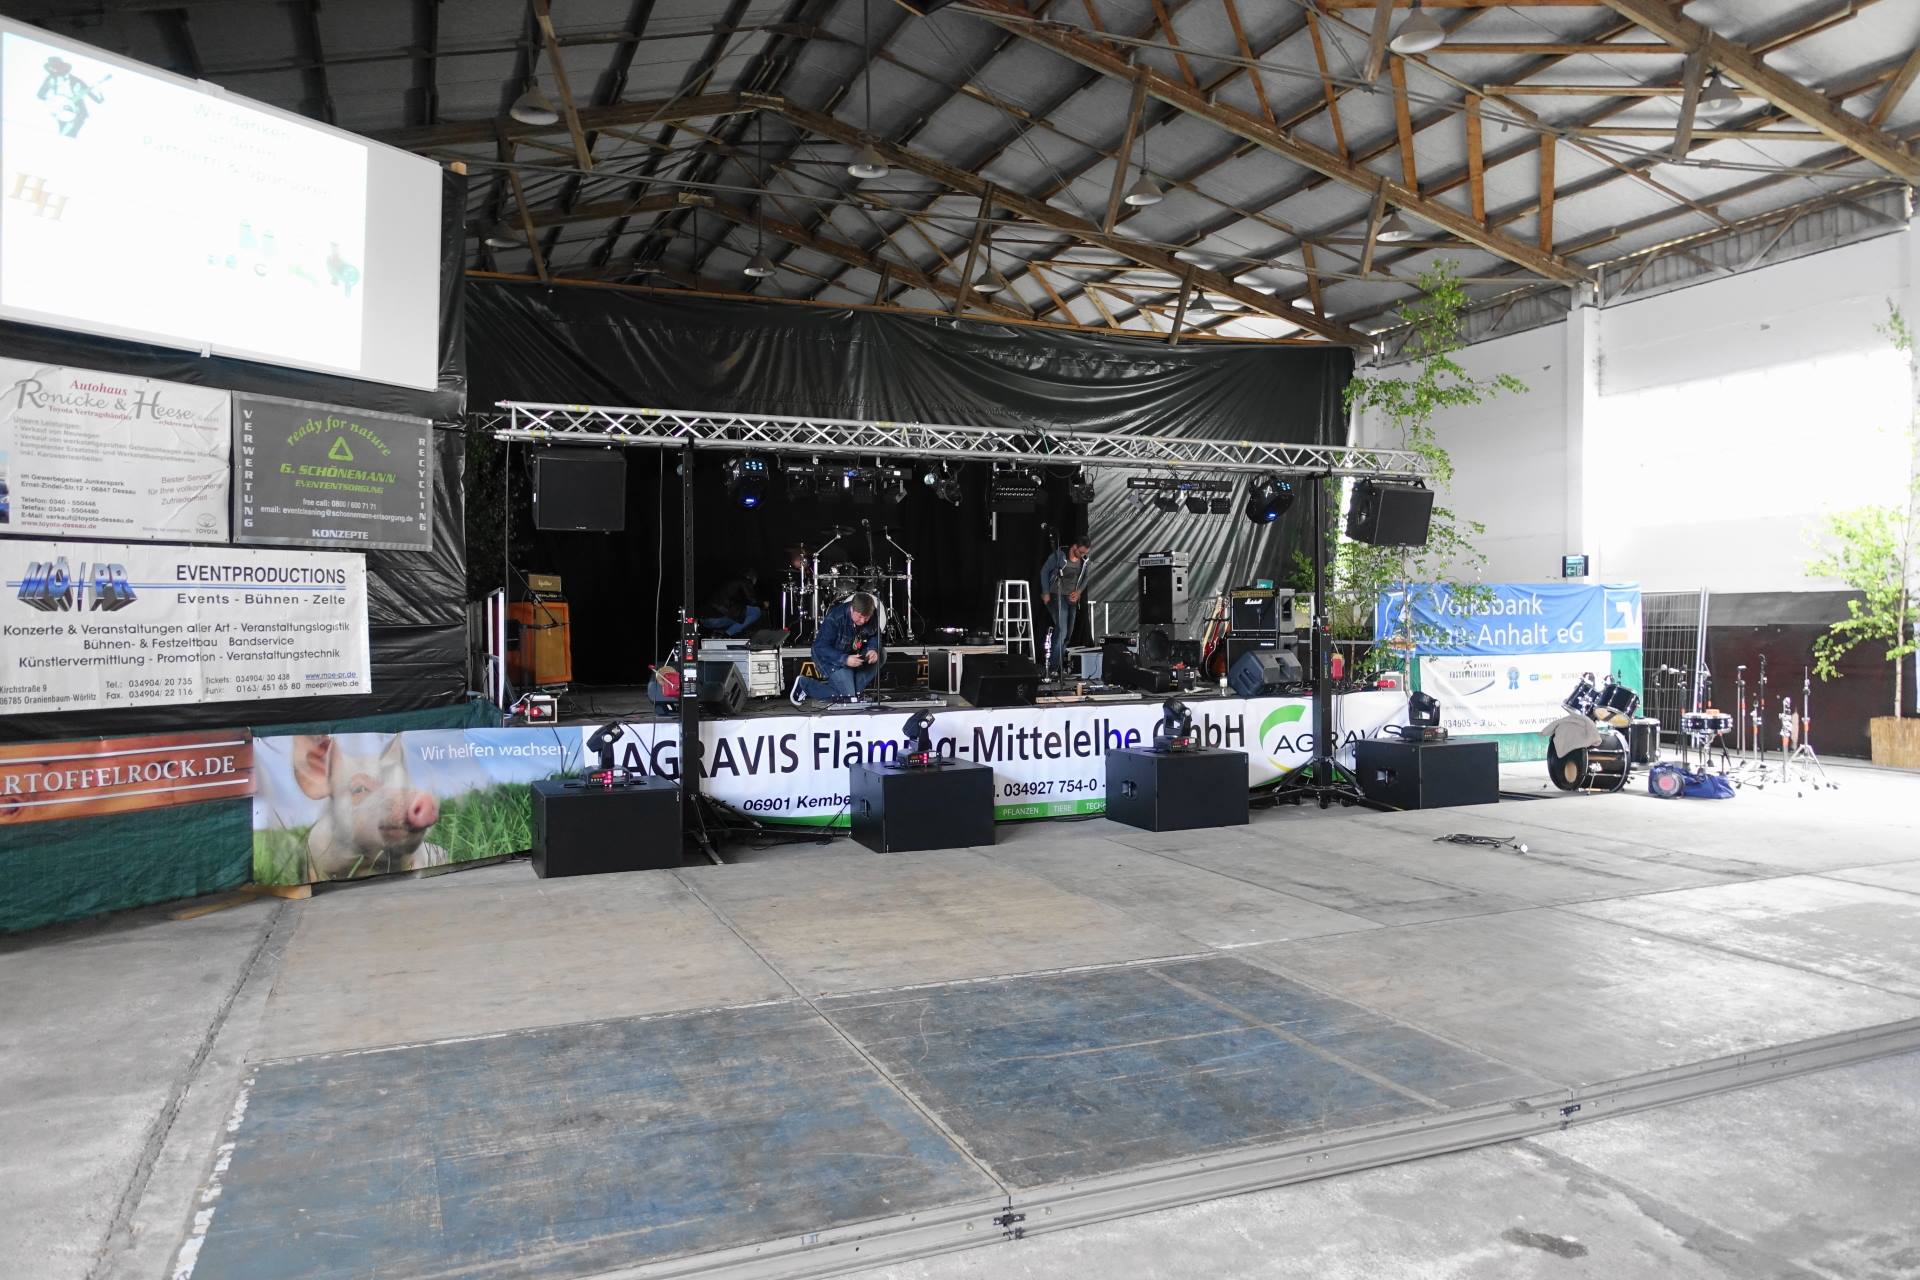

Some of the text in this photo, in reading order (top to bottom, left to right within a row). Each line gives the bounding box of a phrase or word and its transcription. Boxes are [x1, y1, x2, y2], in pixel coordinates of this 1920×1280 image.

[70, 379, 128, 396] Autohaus
[14, 378, 108, 411] Ronicke
[114, 398, 127, 411] &
[133, 390, 195, 421] Heese
[48, 404, 73, 415] Toyota
[287, 414, 392, 457] ready for nature
[242, 410, 255, 528] VERWERTUNG
[280, 463, 397, 484] G. SCHÖNEMANN
[31, 473, 83, 484] Gewerbegebiet
[161, 475, 185, 484] Bester
[418, 437, 427, 531] RECYCLING
[20, 496, 47, 505] Telefon:
[303, 498, 315, 506] free
[316, 499, 330, 507] call:
[362, 502, 369, 510] 71
[260, 505, 281, 514] email:
[20, 521, 97, 530] www.toyota-dessau.de
[195, 528, 219, 536] TOYOTA
[312, 529, 369, 540] KONZEPTE
[176, 564, 346, 584] EVENTPRODUCTIONS
[177, 592, 230, 605] Events
[244, 592, 299, 605] Bühnen
[312, 593, 346, 605] Zelte
[3, 624, 64, 636] Konzerte
[68, 624, 78, 635] &
[81, 623, 183, 636] Veranstaltungen
[186, 622, 211, 634] aller
[214, 622, 230, 633] Art
[241, 621, 350, 634] Veranstaltungslogistik
[1556, 621, 1583, 645] eG
[84, 635, 295, 650] Bühnen- & Festzeltbau Bandservice
[19, 654, 145, 668] Künstlervermittlung
[157, 652, 216, 663] Promotion
[226, 648, 340, 662] Veranstaltungstechnik
[164, 678, 175, 687] 20
[178, 678, 193, 686] 735
[267, 674, 276, 682] 30
[277, 673, 291, 681] 438
[305, 671, 357, 680] www.moe-pr.de
[164, 688, 175, 697] 22
[178, 688, 193, 697] 116
[290, 682, 301, 690] 80
[420, 742, 572, 761] Wir helfen wachsen.
[0, 756, 236, 795] RTOFFELROCK.DE
[1004, 780, 1054, 798] 034927
[1059, 777, 1098, 793] 754-0
[742, 797, 790, 812] 06901
[796, 792, 851, 809] Kembe
[1003, 806, 1040, 817] PFLANZEN
[1053, 803, 1073, 813] TIERE
